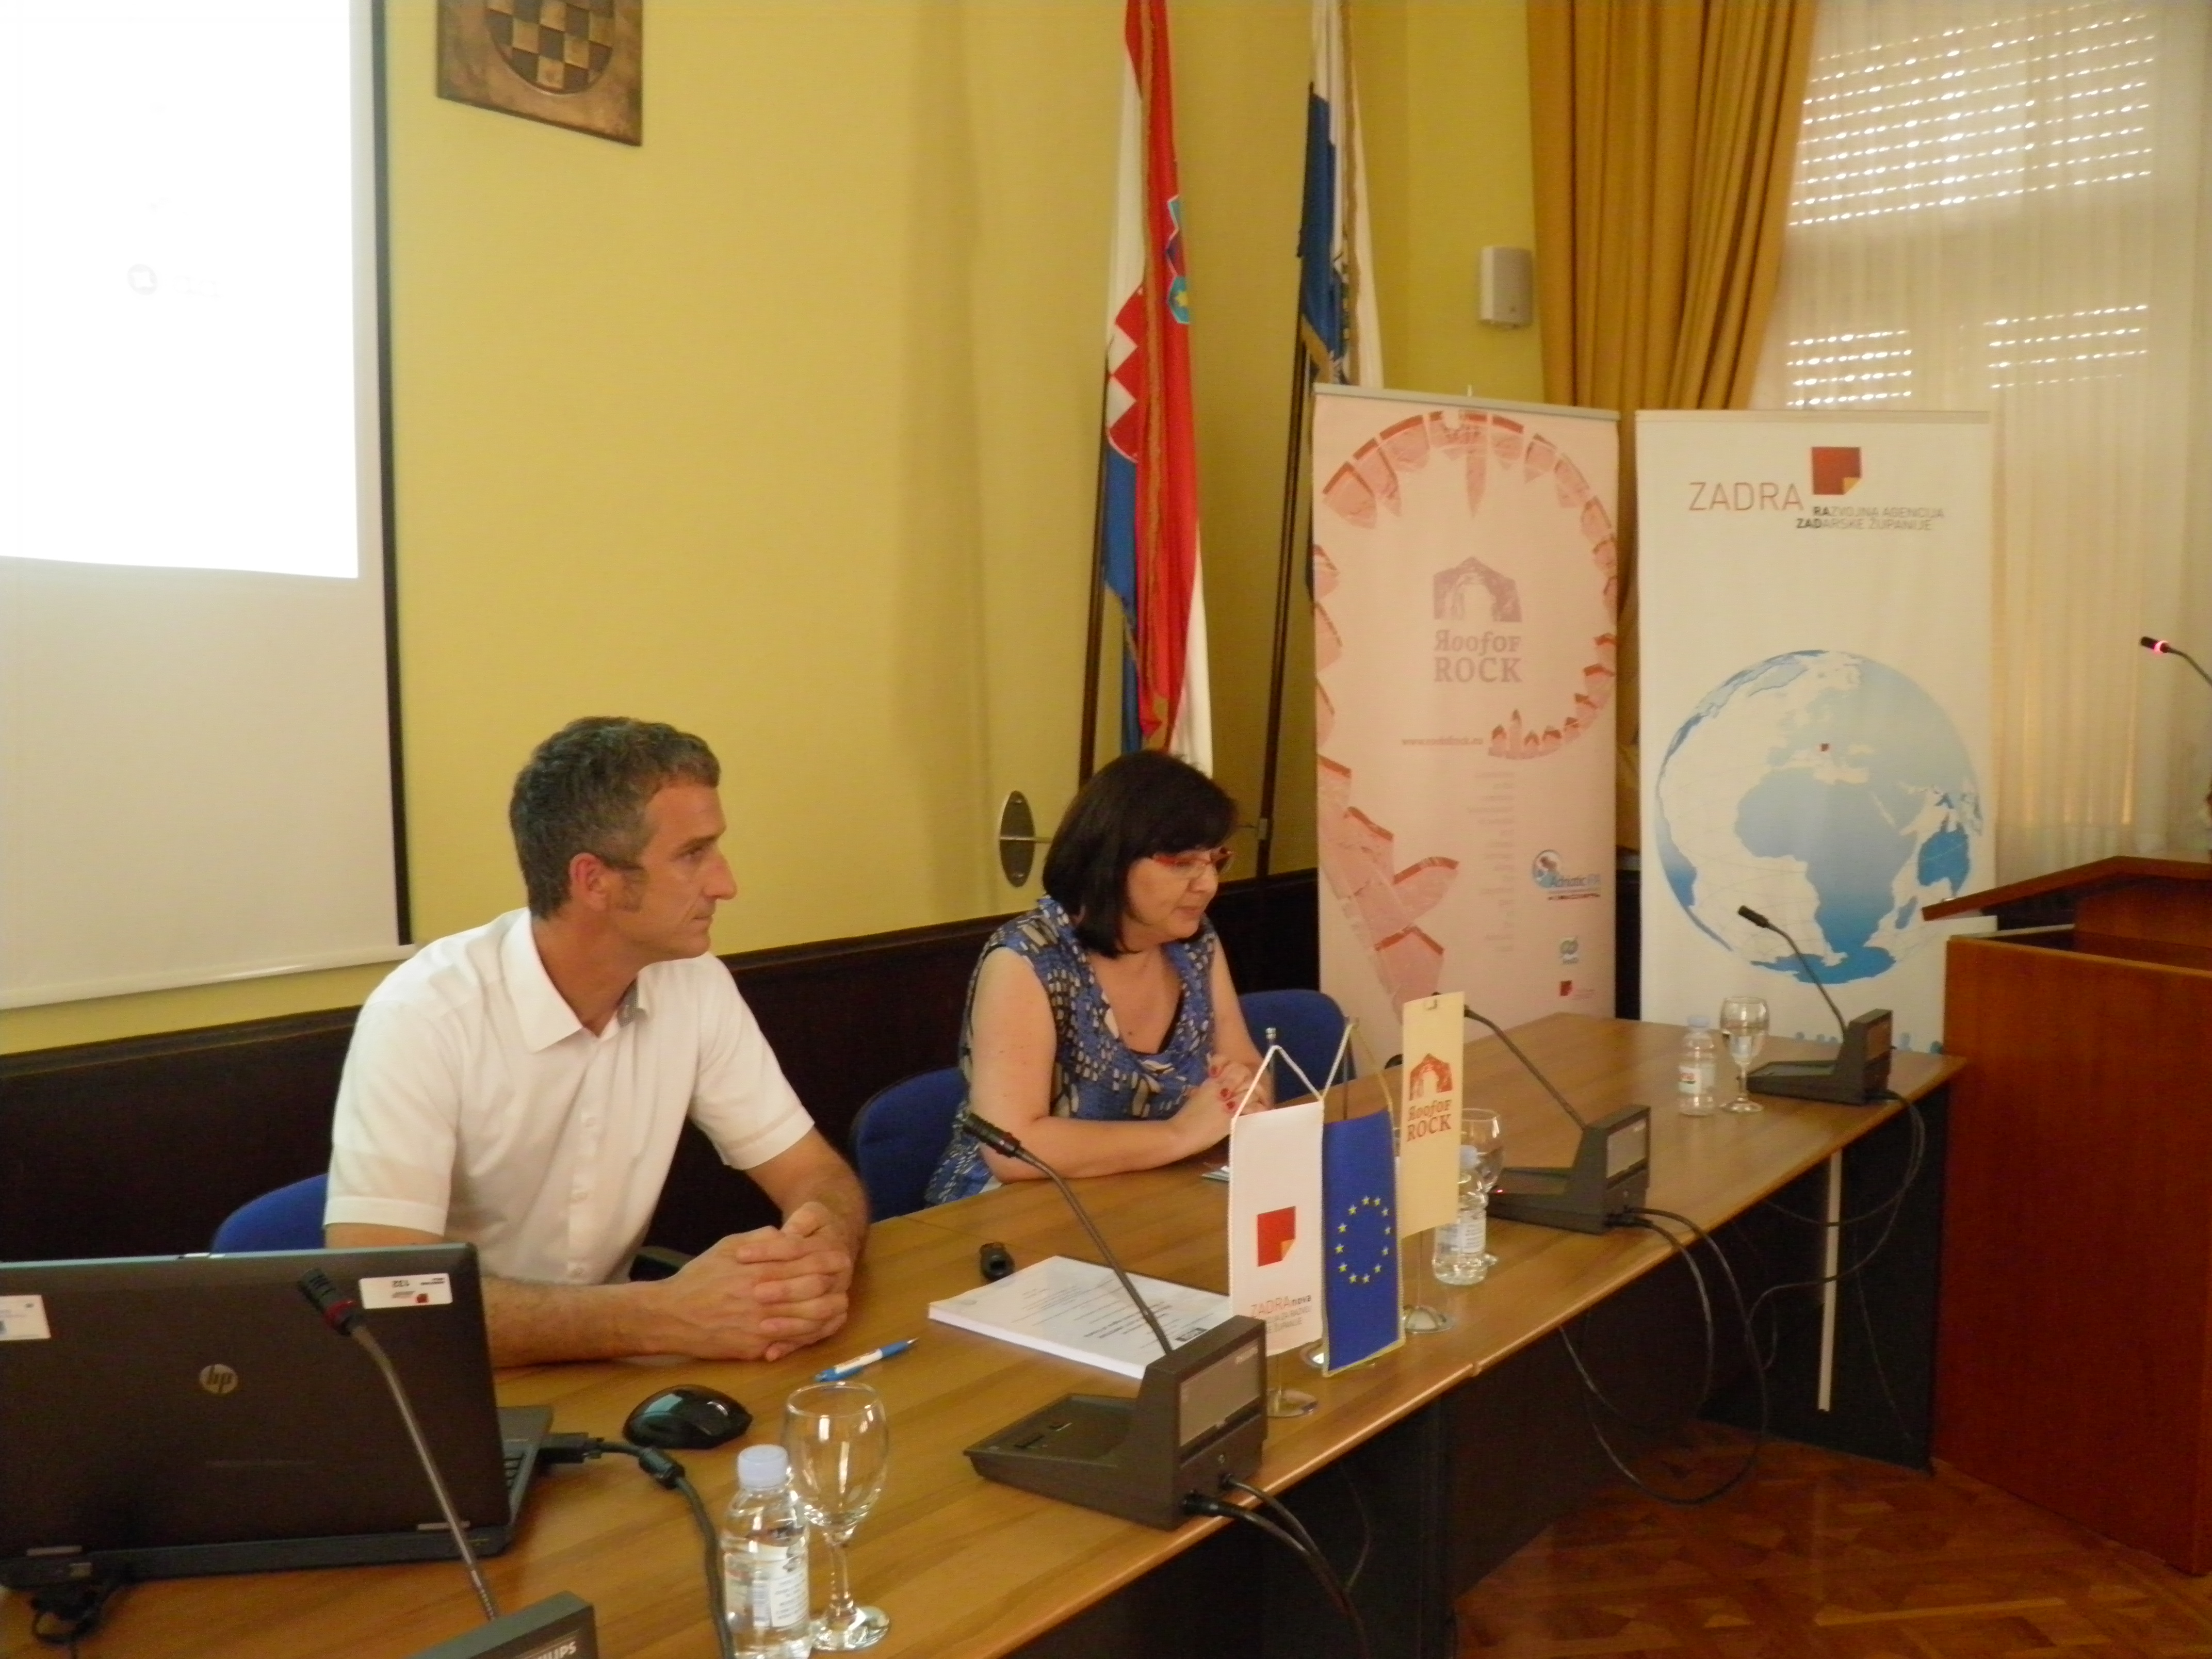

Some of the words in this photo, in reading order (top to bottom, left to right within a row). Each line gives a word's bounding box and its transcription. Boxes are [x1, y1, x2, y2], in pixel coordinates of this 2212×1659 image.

[1688, 481, 1805, 512] ZADRA
[1434, 657, 1522, 683] ROCK
[1406, 1113, 1452, 1142] ROCK
[206, 1364, 234, 1394] hp
